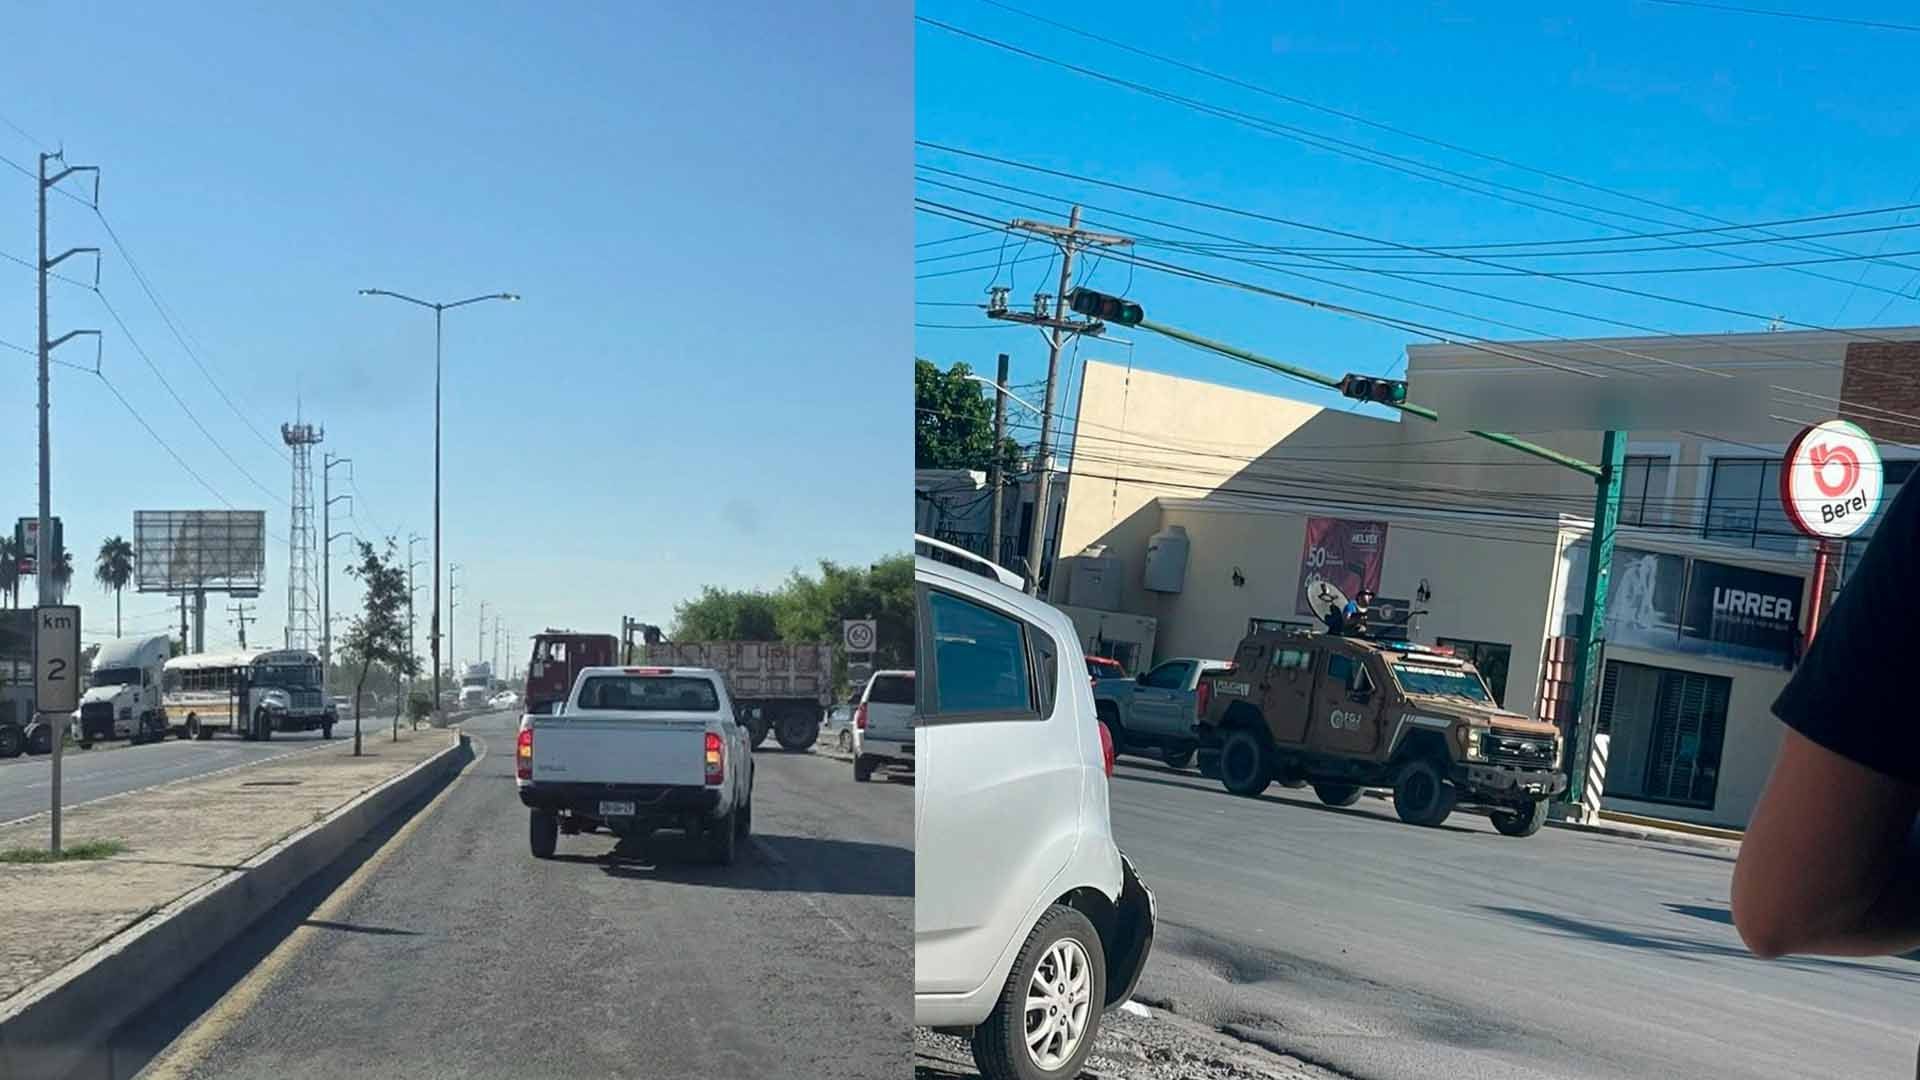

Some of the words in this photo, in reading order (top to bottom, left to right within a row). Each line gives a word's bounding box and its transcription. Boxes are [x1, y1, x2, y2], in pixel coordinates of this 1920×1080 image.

[1821, 489, 1867, 524] Berel
[1306, 545, 1325, 567] 50
[1713, 586, 1793, 620] URREA
[44, 614, 71, 628] km
[852, 629, 868, 641] 60
[47, 658, 66, 681] 2
